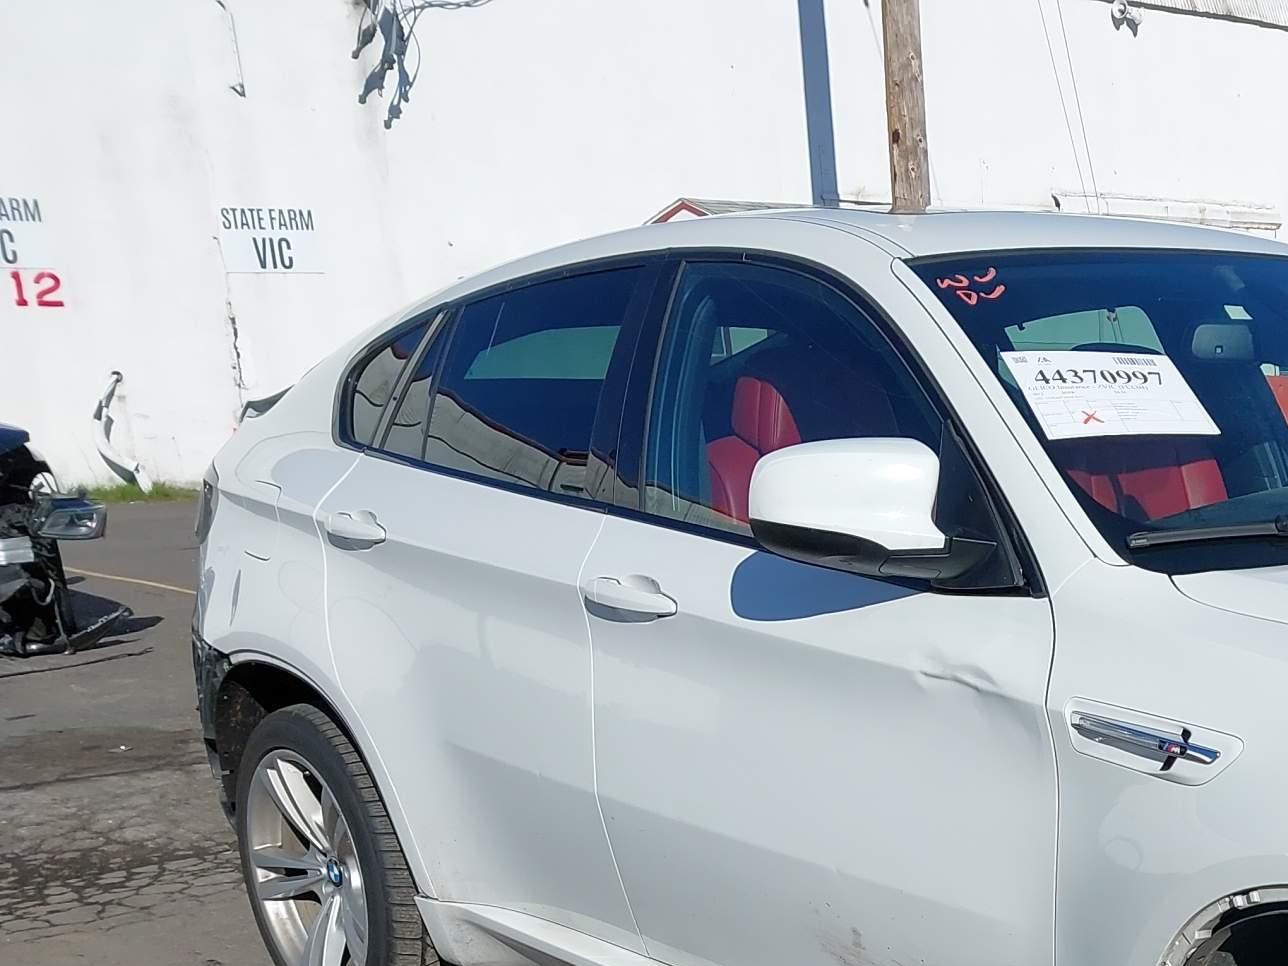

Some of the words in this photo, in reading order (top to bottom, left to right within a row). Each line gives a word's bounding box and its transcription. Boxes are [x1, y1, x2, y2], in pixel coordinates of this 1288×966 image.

[0, 197, 42, 223] ARM
[220, 207, 266, 230] STATE
[268, 208, 315, 231] FARM
[252, 236, 294, 270] VIC
[10, 271, 64, 307] 12
[1034, 369, 1162, 386] 44370997
